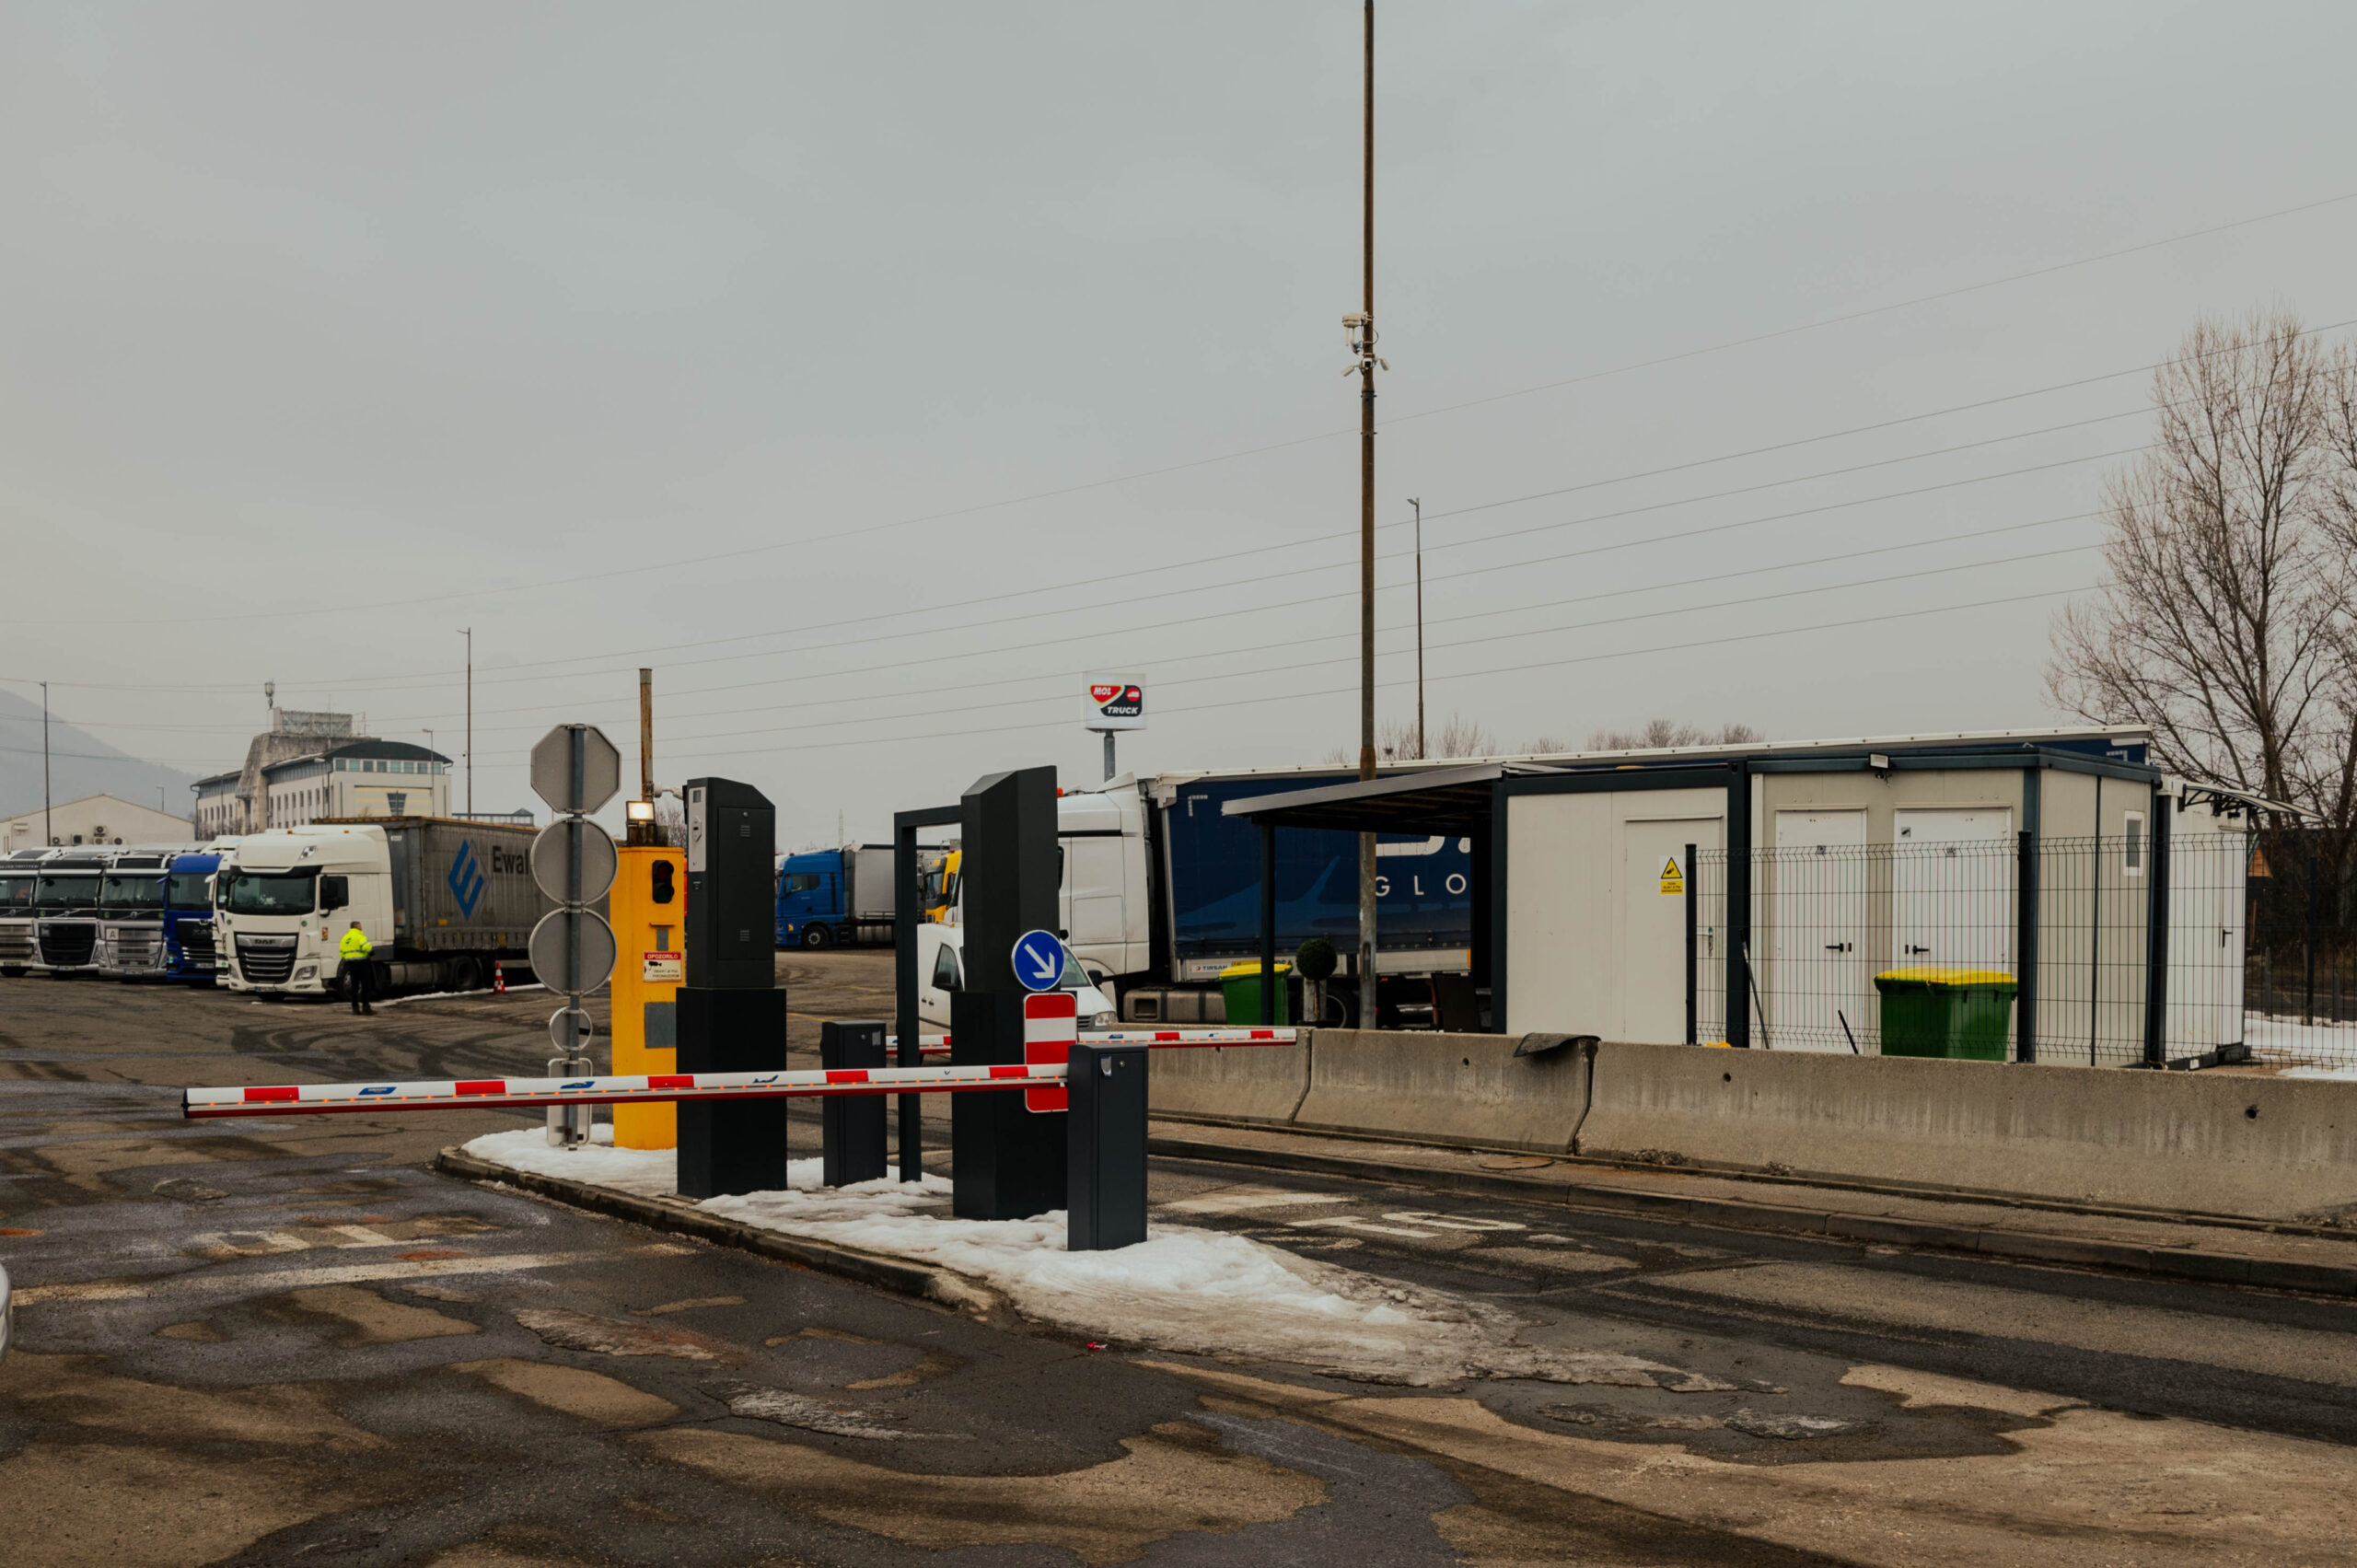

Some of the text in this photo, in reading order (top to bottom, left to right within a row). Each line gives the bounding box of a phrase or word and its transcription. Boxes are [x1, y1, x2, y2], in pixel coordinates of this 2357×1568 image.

[1093, 687, 1112, 696] MOL
[1107, 706, 1139, 714] TRUCK
[110, 930, 116, 938] A
